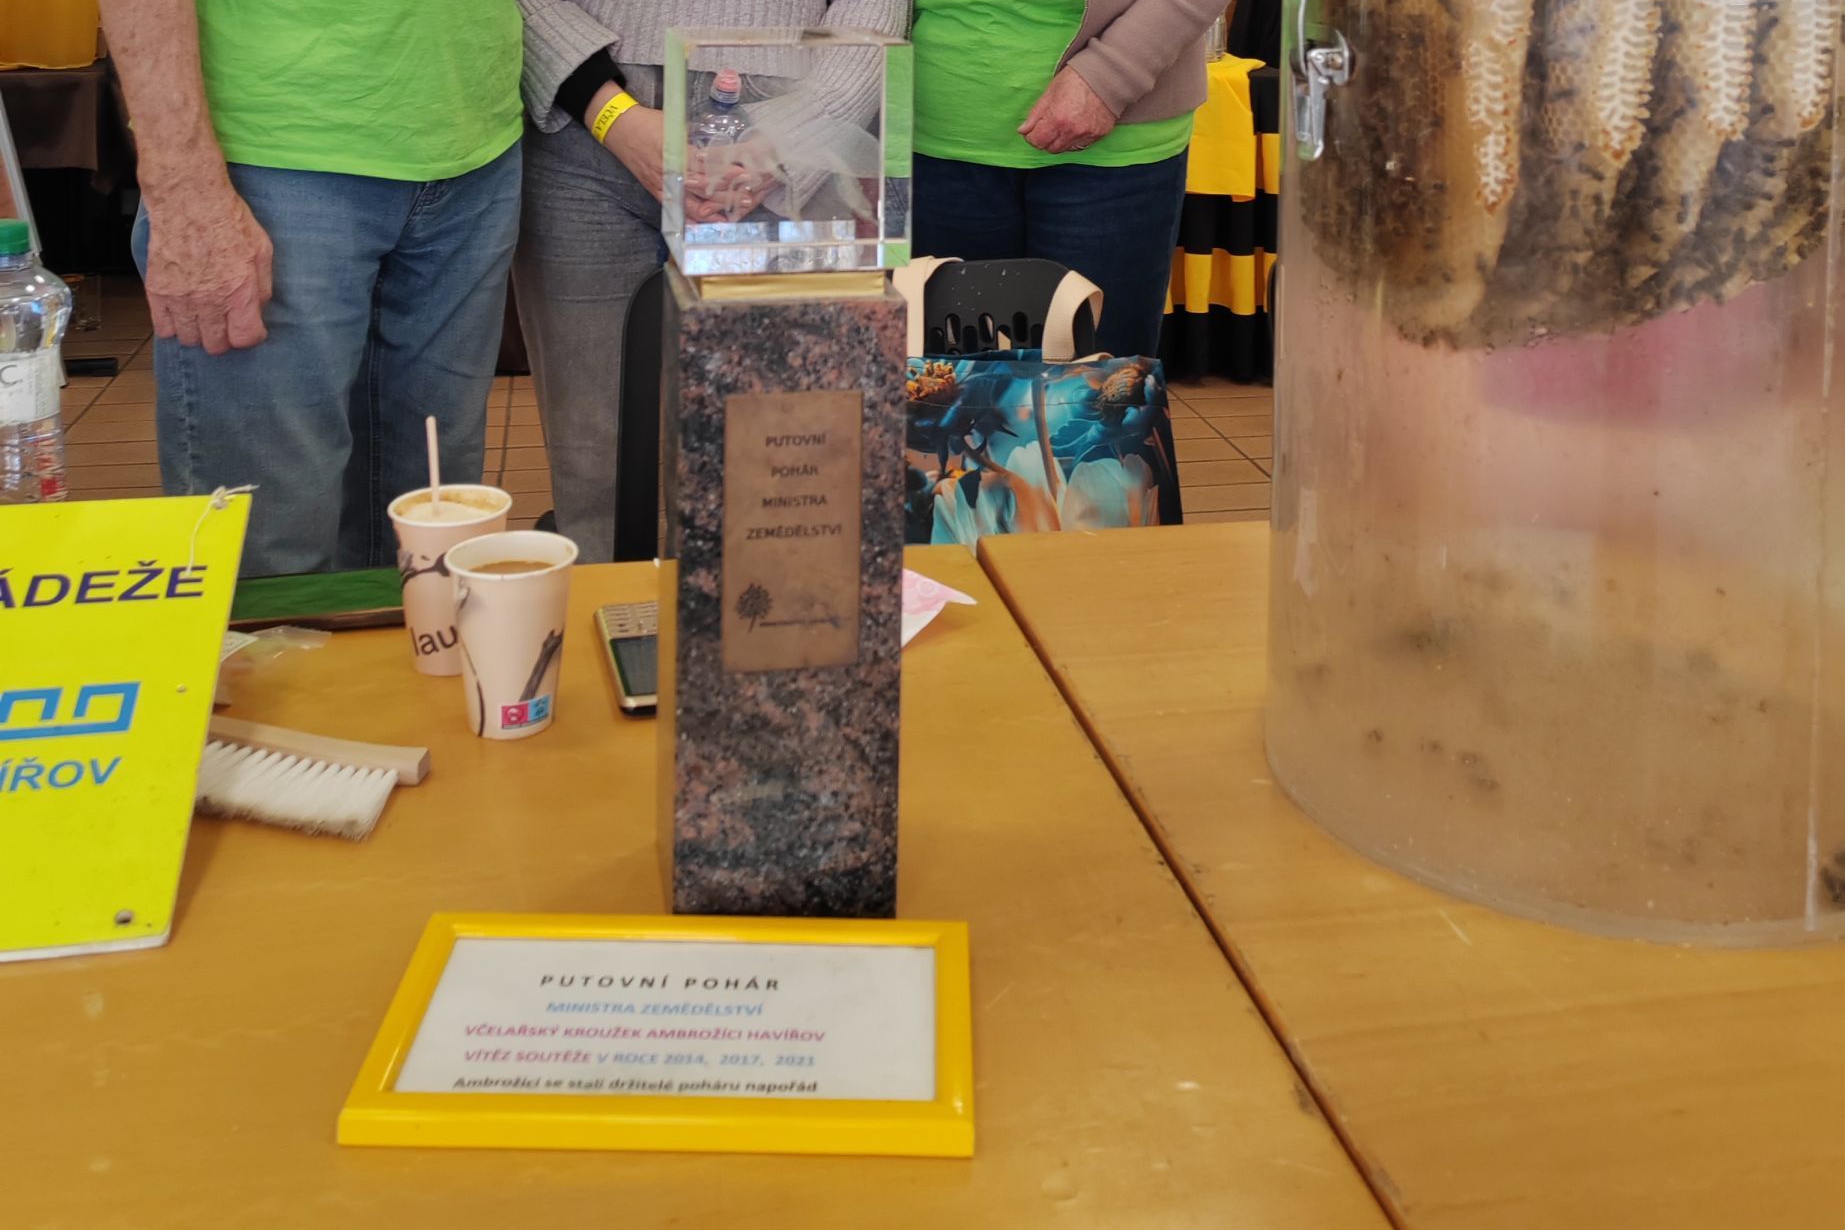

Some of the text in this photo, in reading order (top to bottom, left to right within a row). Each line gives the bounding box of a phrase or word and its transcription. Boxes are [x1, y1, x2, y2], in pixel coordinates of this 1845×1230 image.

[765, 431, 827, 448] PUTOVNÍ
[770, 463, 819, 478] POHÁR
[761, 494, 828, 508] MINISTRA
[540, 974, 779, 992] PUTOVNÍ POHÁR
[546, 1001, 636, 1014] MINISTRA
[464, 1023, 827, 1043] VČELAŘSKÝ KROUŽEK AMBROŽÍCI HAVÍŘOV
[464, 1048, 512, 1063] VÍTĚZ
[514, 1048, 593, 1064] SOUTĚŽE
[596, 1053, 609, 1064] V
[612, 1053, 658, 1065] ROCE
[451, 1075, 819, 1094] Ambrožíci se stali držitelé poháru napořád
